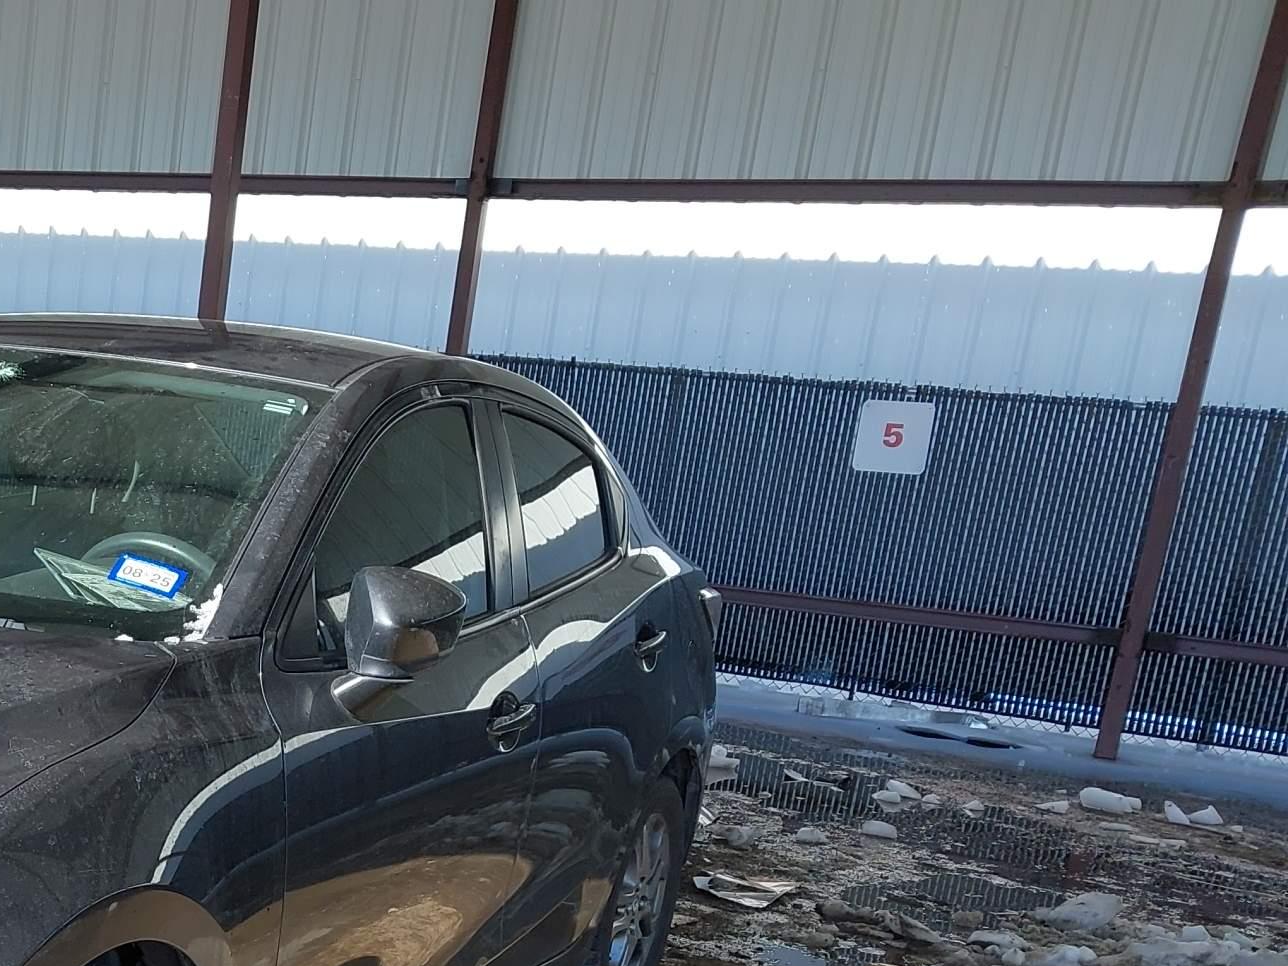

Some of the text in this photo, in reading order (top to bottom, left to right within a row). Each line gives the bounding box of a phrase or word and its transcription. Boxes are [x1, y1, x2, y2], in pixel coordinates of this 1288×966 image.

[882, 422, 905, 448] 5
[122, 565, 172, 587] 08 25
